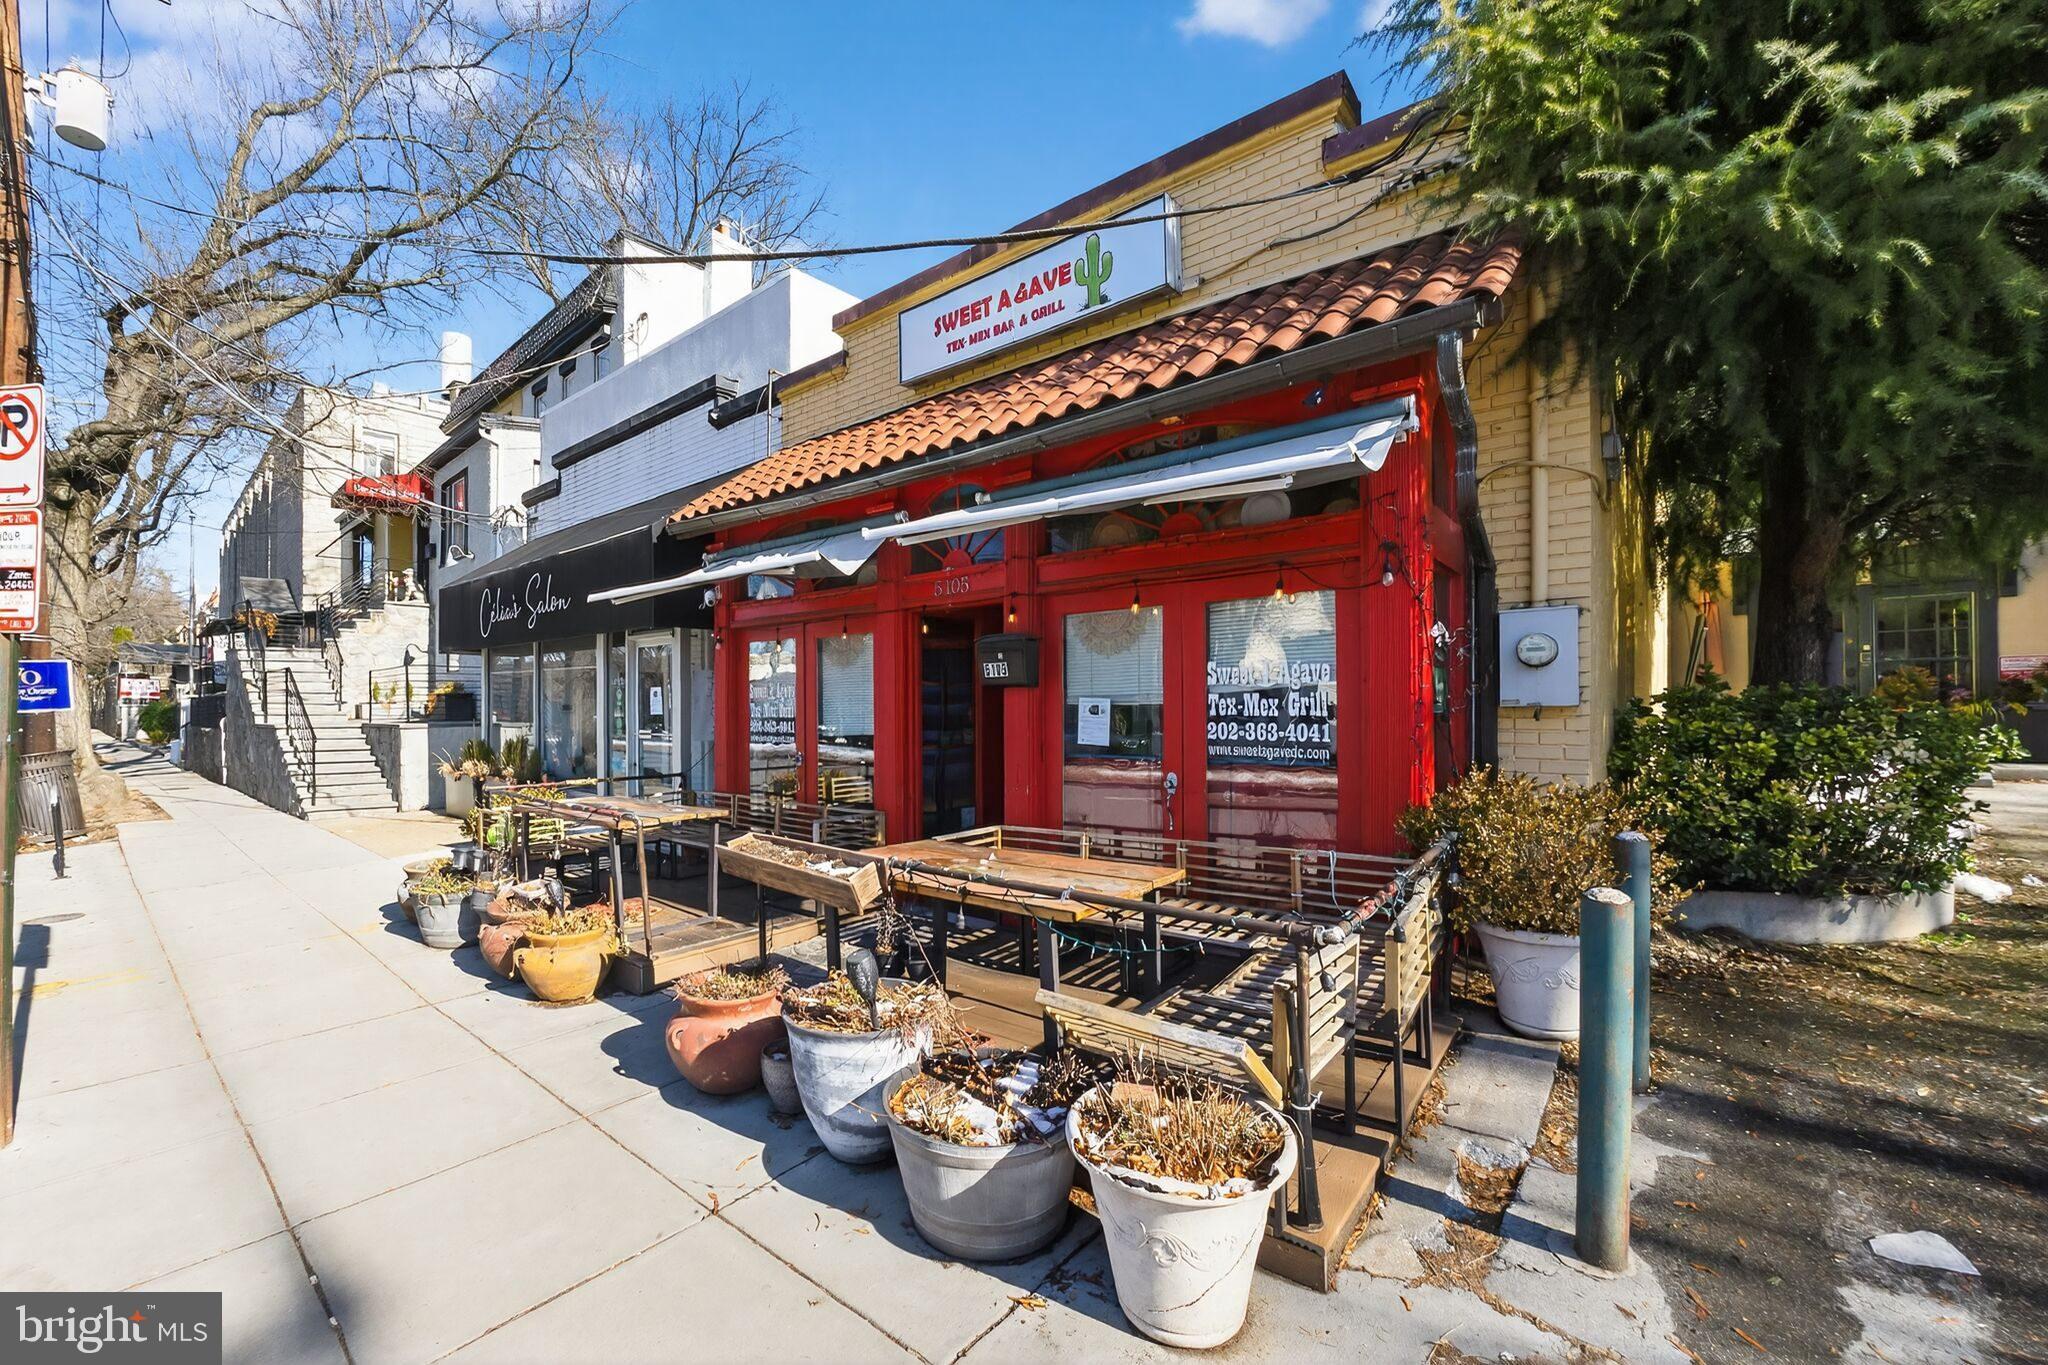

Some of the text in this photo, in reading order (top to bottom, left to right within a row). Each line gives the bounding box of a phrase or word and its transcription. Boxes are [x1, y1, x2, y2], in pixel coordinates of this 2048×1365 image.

[933, 261, 1072, 337] SWEET AGAVE
[993, 319, 1015, 337] BAR
[1019, 313, 1028, 327] &
[1031, 299, 1066, 322] GRILL
[525, 572, 571, 629] Salon
[933, 576, 969, 597] 5105
[1277, 660, 1331, 690] Agave
[1208, 692, 1279, 717] Tex-Mex
[1207, 722, 1331, 743] 202-363-4041
